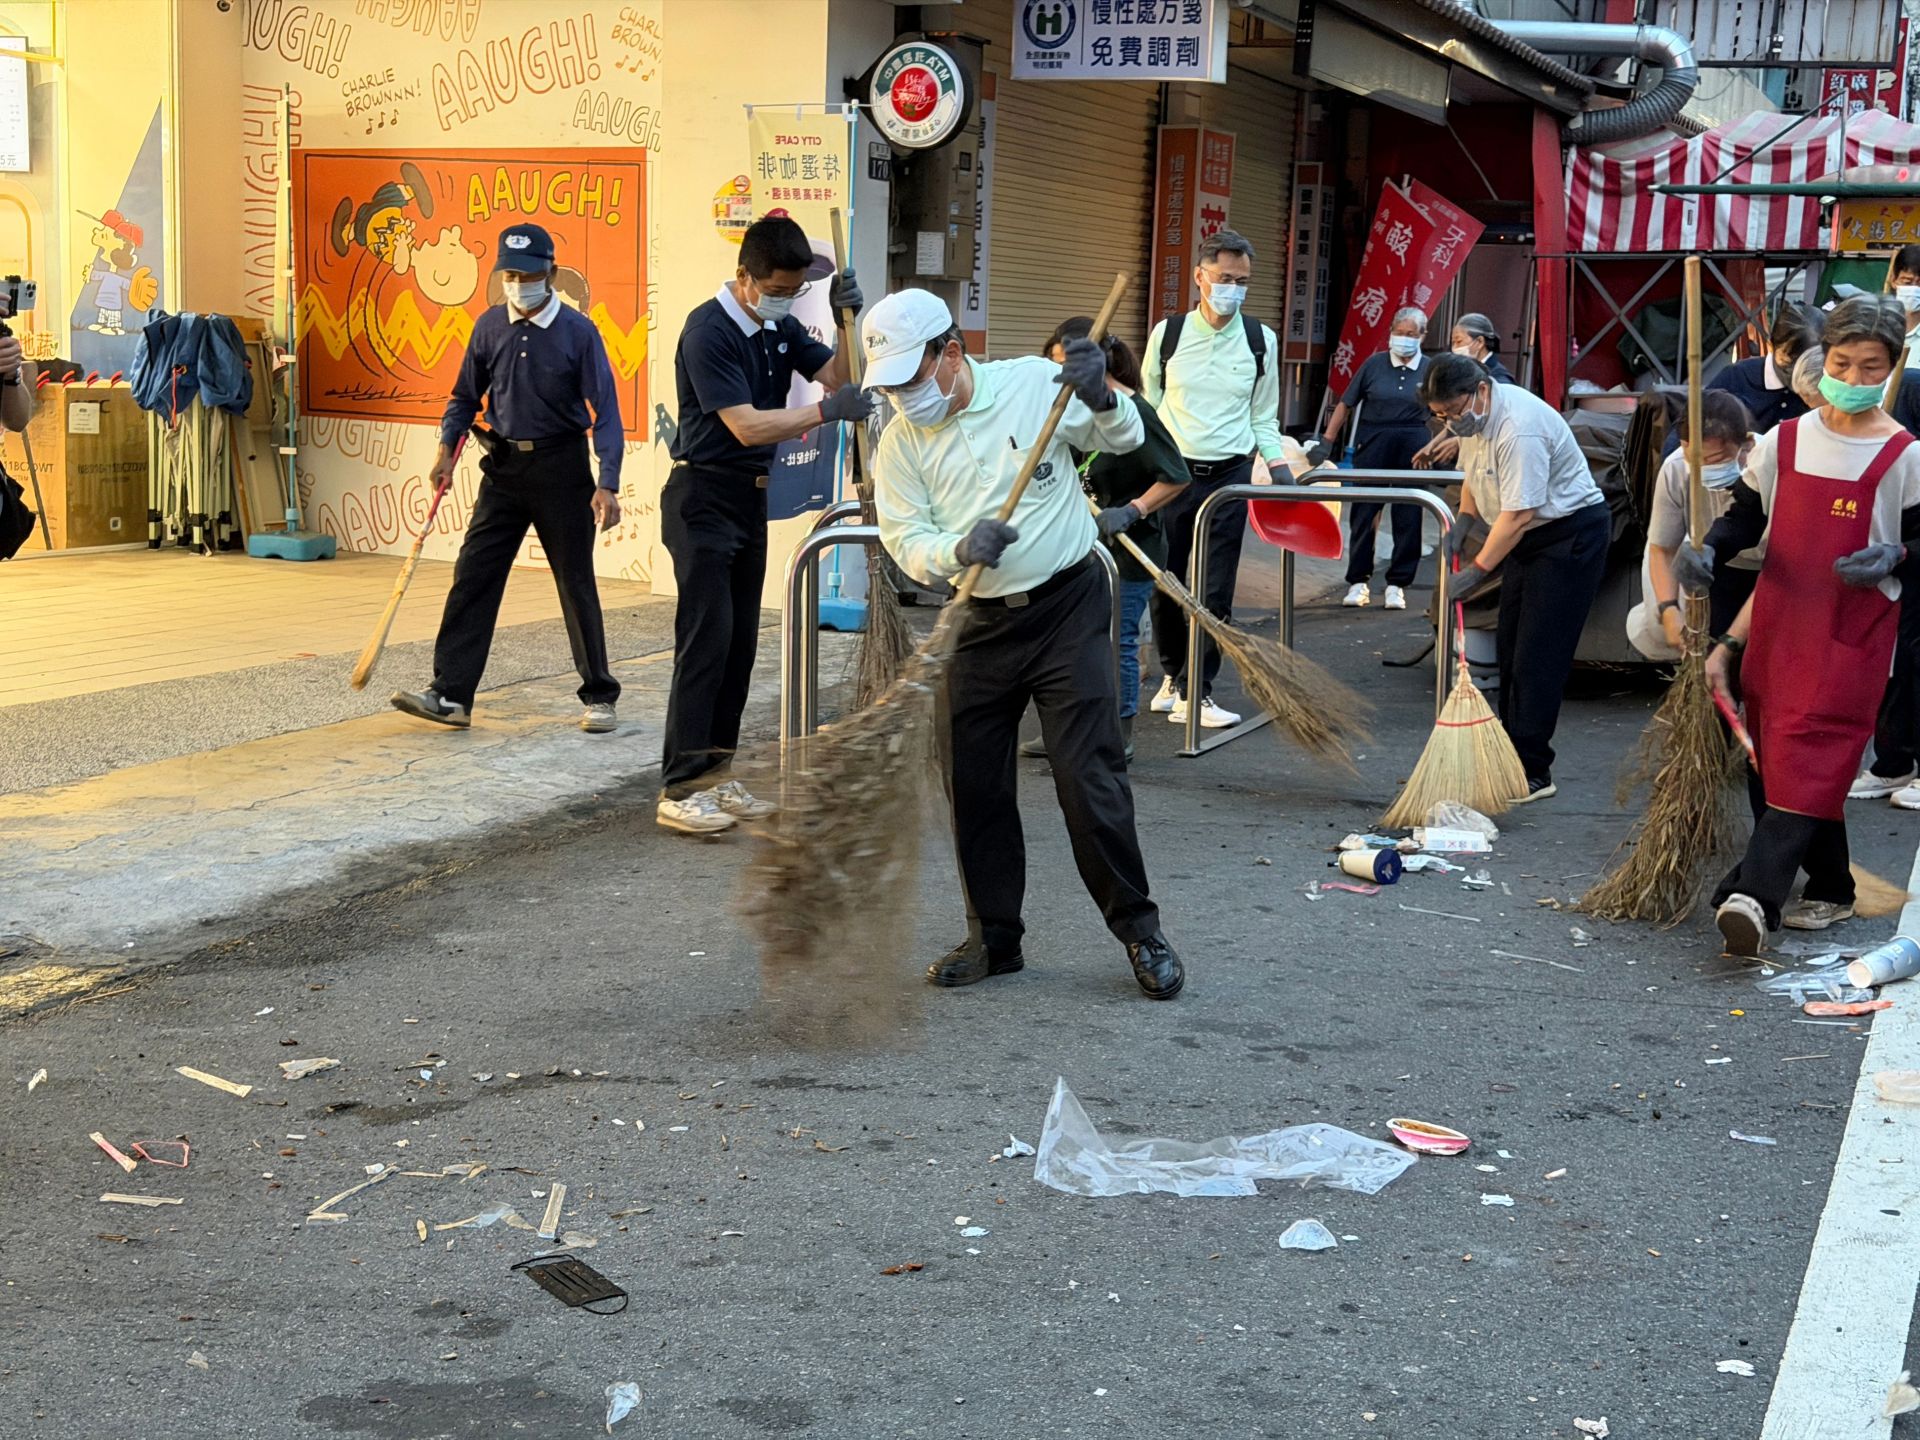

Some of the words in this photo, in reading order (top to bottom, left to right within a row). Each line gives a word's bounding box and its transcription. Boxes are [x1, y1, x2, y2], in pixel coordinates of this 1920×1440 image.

[243, 0, 352, 79] UGH!
[619, 6, 663, 40] CHARL
[611, 24, 663, 64] BROWN
[1091, 36, 1201, 67] 免費調劑
[341, 68, 396, 98] CHARLIE
[432, 13, 601, 131] AAUGH!
[345, 80, 422, 119] BROWNNN!
[872, 160, 889, 179] 170
[466, 166, 623, 228] AAUGH!
[318, 466, 476, 552] AAUGH!
